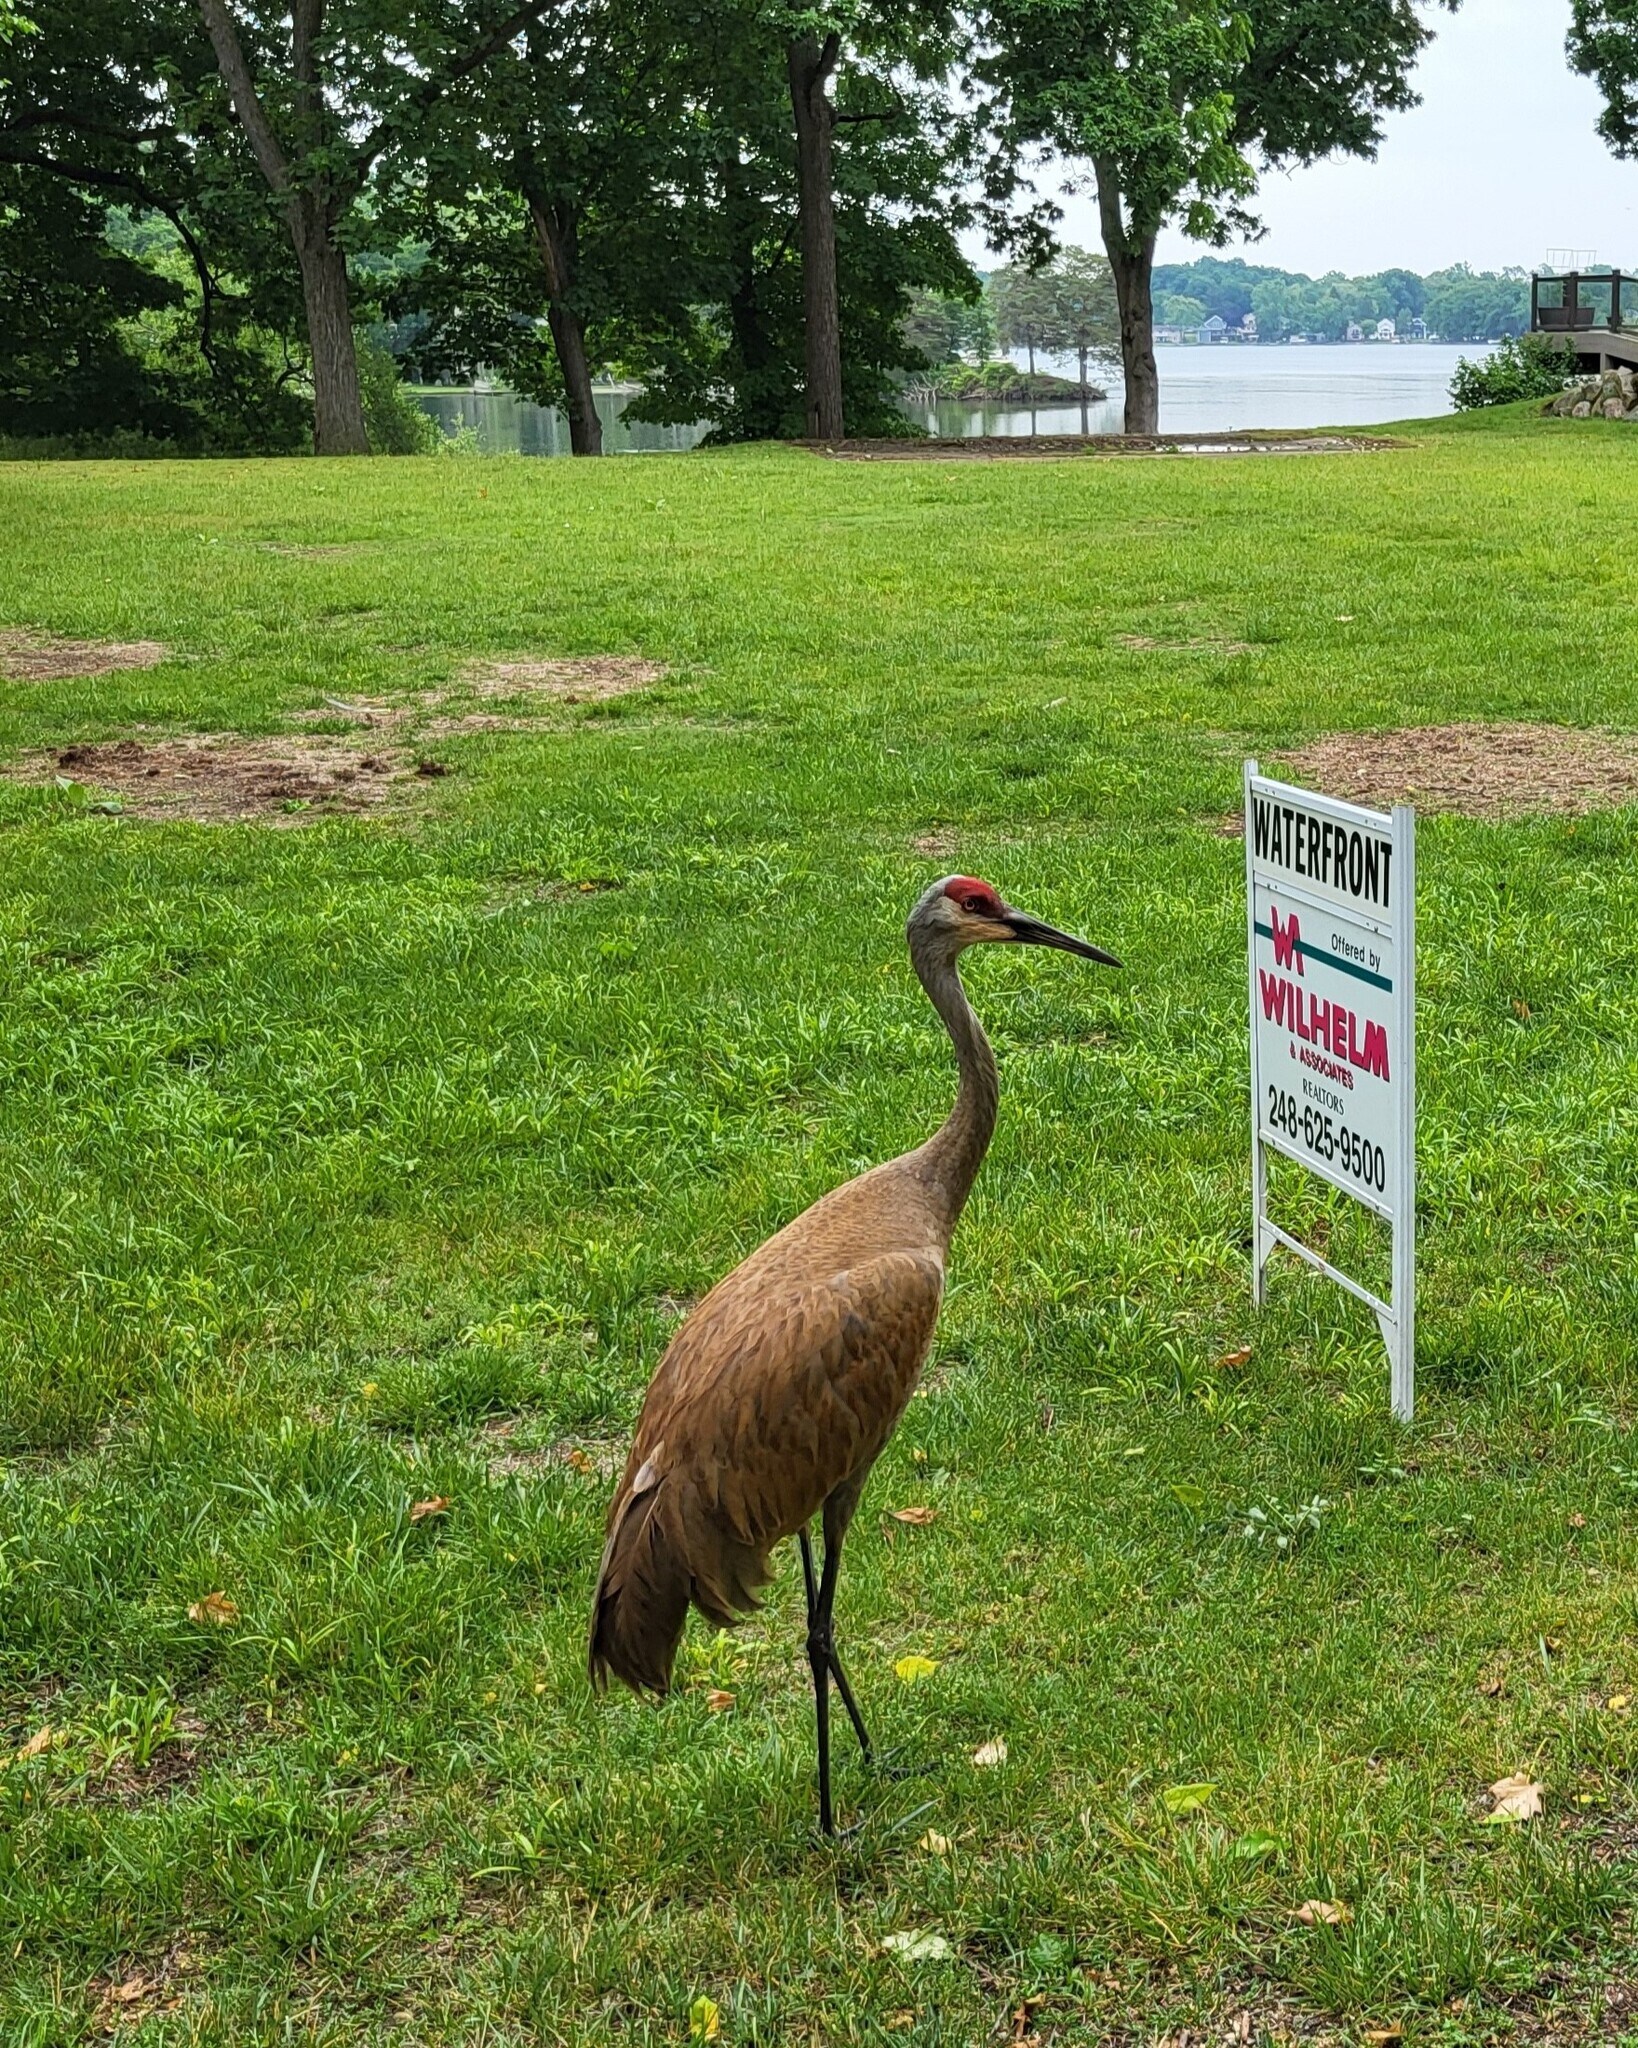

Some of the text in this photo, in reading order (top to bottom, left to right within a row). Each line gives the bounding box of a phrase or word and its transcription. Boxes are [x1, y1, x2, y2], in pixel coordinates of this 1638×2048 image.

[1253, 797, 1392, 908] WATERFRONT
[1331, 933, 1381, 973] Offered by
[1259, 968, 1390, 1083] WILHELM
[1290, 1040, 1354, 1091] & ASSOCIATES
[1302, 1078, 1345, 1115] REALTORS
[1268, 1084, 1386, 1193] 248-625-9500
